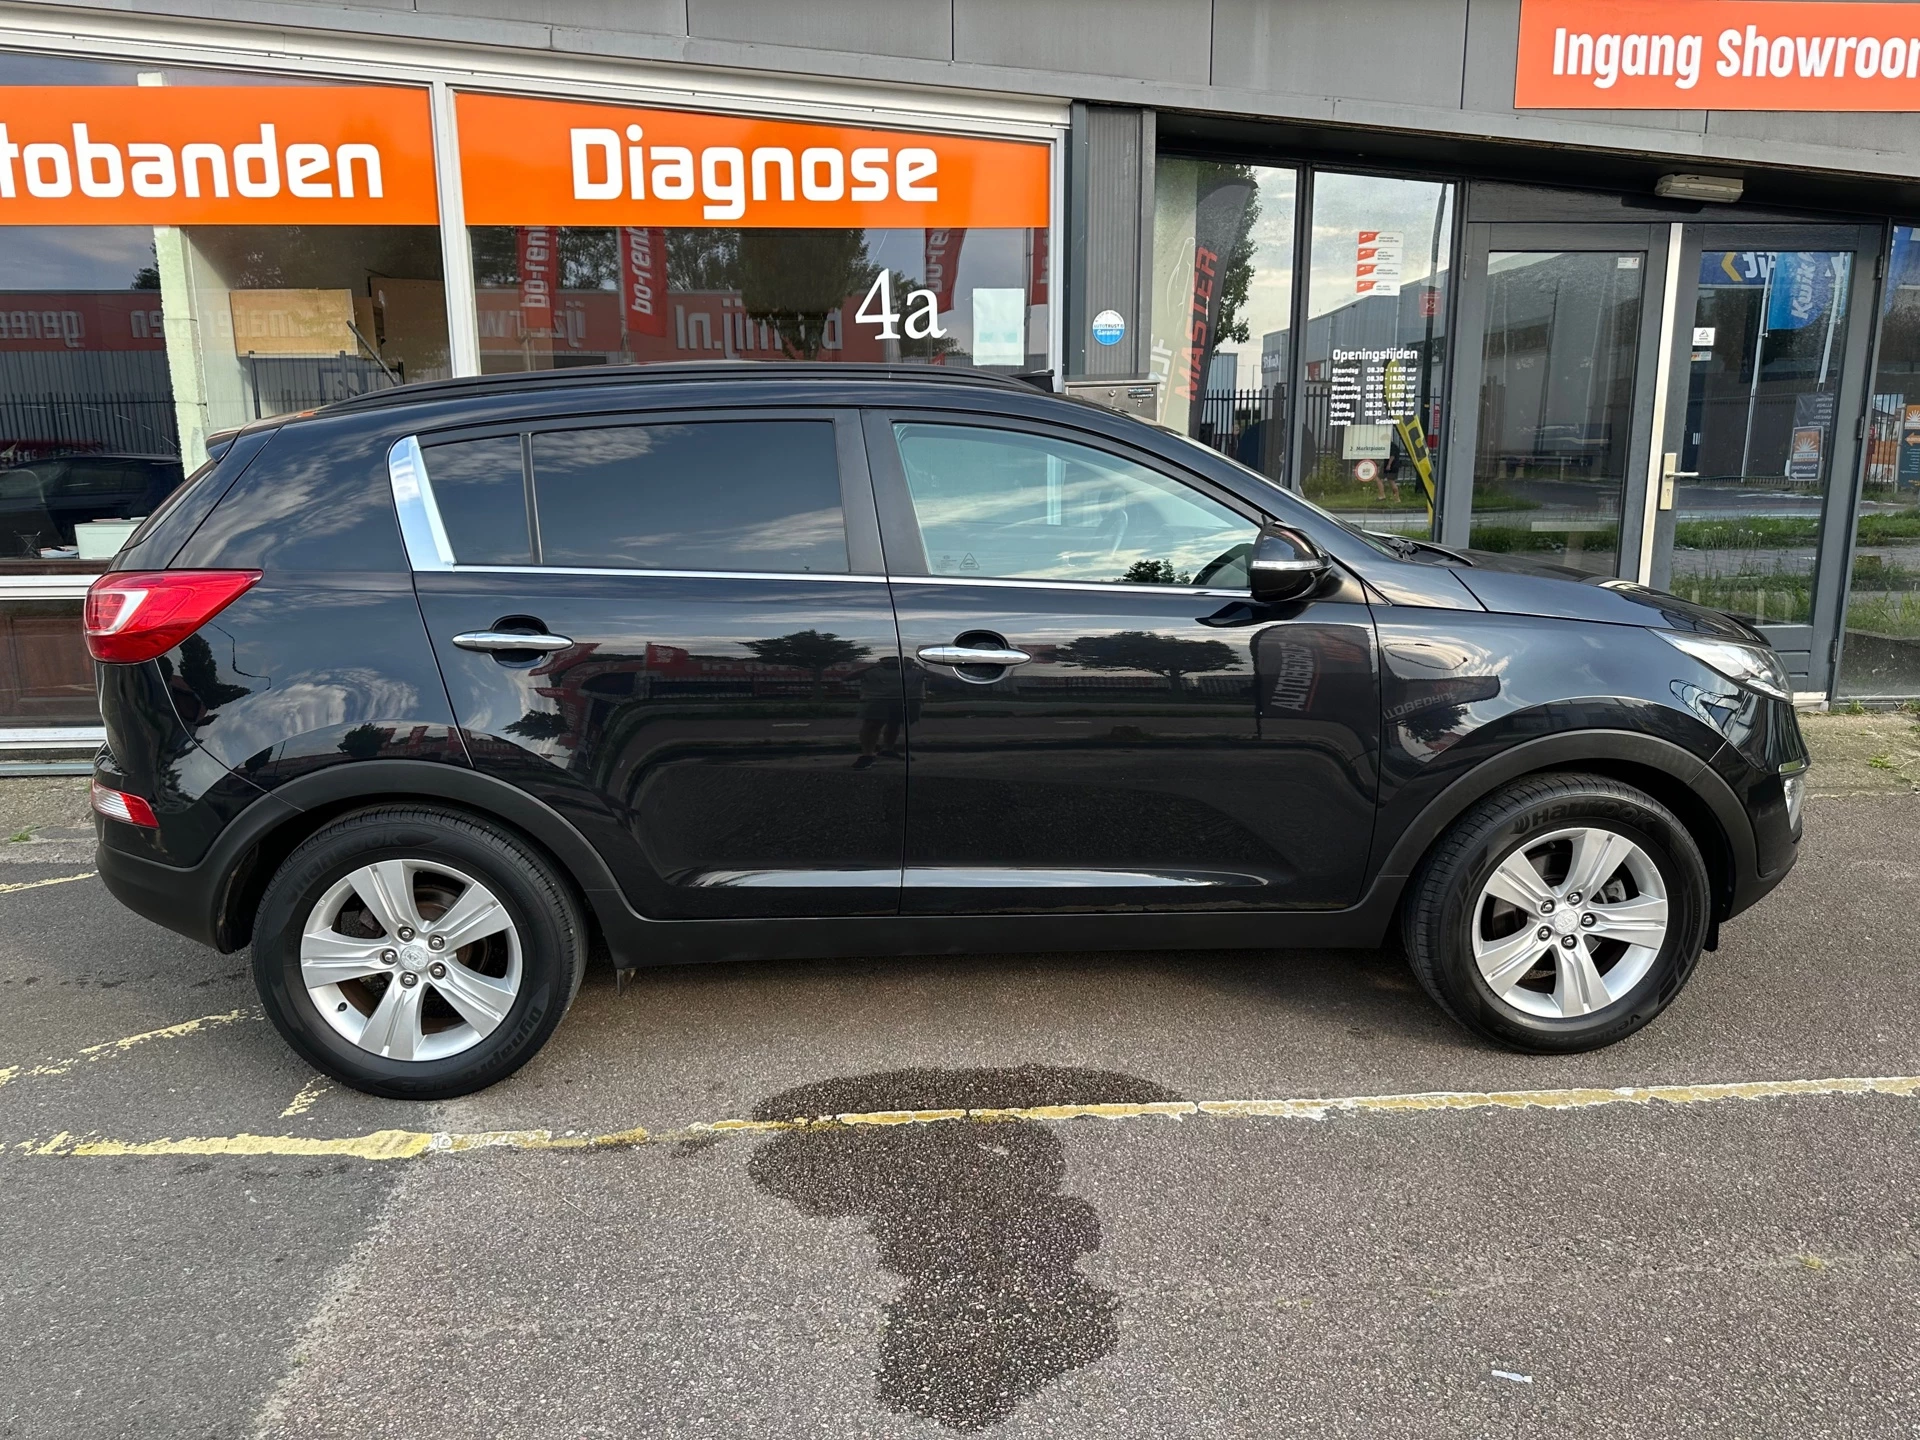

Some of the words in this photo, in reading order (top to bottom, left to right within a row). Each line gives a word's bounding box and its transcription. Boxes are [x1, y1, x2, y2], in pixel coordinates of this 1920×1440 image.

[1553, 27, 1702, 89] Ingang
[570, 123, 938, 220] Diagnose
[855, 268, 947, 339] 4a
[1175, 246, 1218, 401] MASTER
[1332, 348, 1417, 363] Openingstijden
